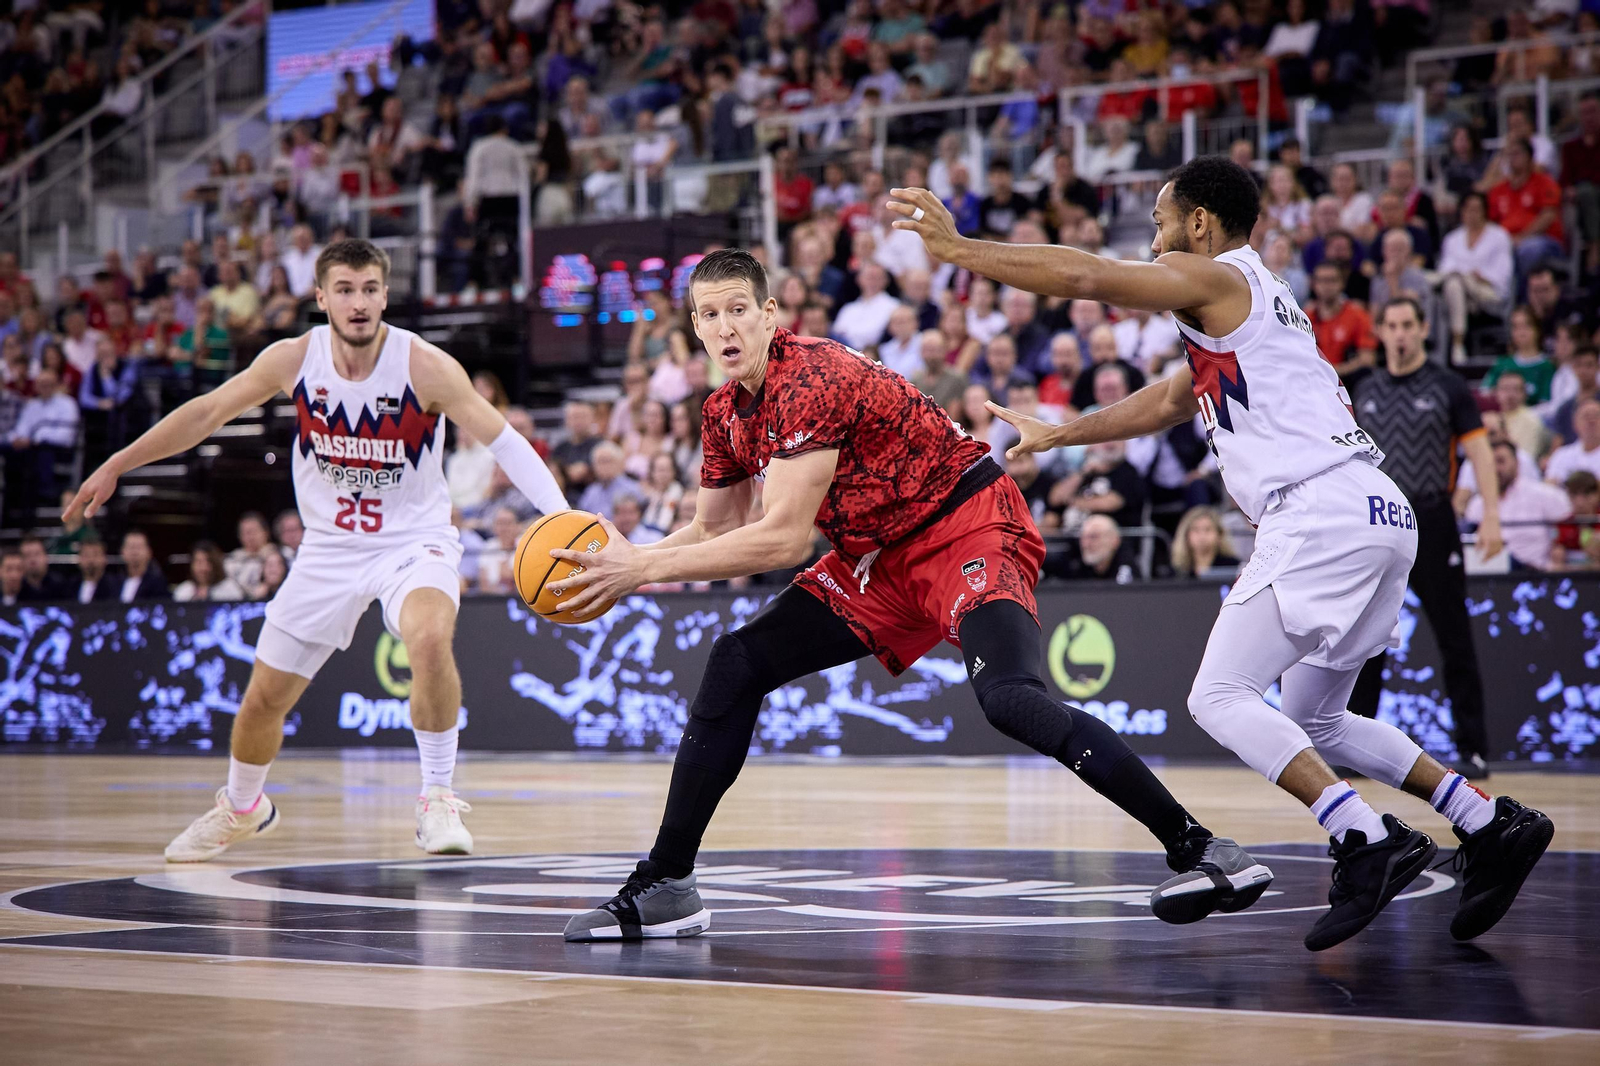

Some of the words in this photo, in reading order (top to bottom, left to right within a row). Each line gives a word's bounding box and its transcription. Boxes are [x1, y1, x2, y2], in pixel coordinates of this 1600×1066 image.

[310, 430, 407, 463] BASKONIA
[318, 458, 404, 486] kosner
[335, 496, 383, 533] 25
